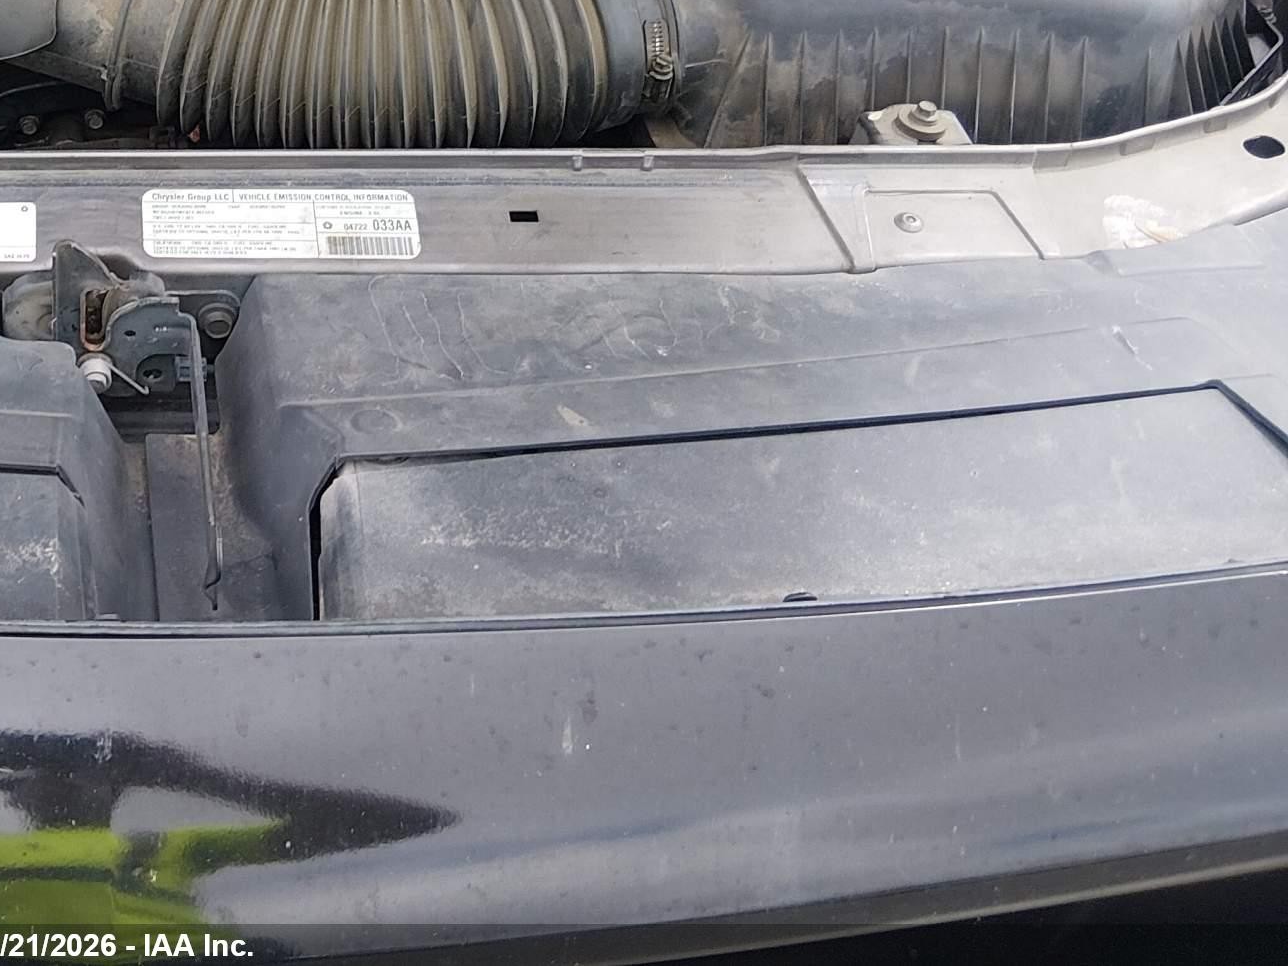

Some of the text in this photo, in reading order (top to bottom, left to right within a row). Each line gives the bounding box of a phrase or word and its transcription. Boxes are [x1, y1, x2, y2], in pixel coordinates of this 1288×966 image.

[152, 193, 230, 202] Chrysler Group LLC
[239, 193, 408, 201] VEHICLE EMISSION CONTROL INFORMATION
[372, 219, 413, 231] 033AA
